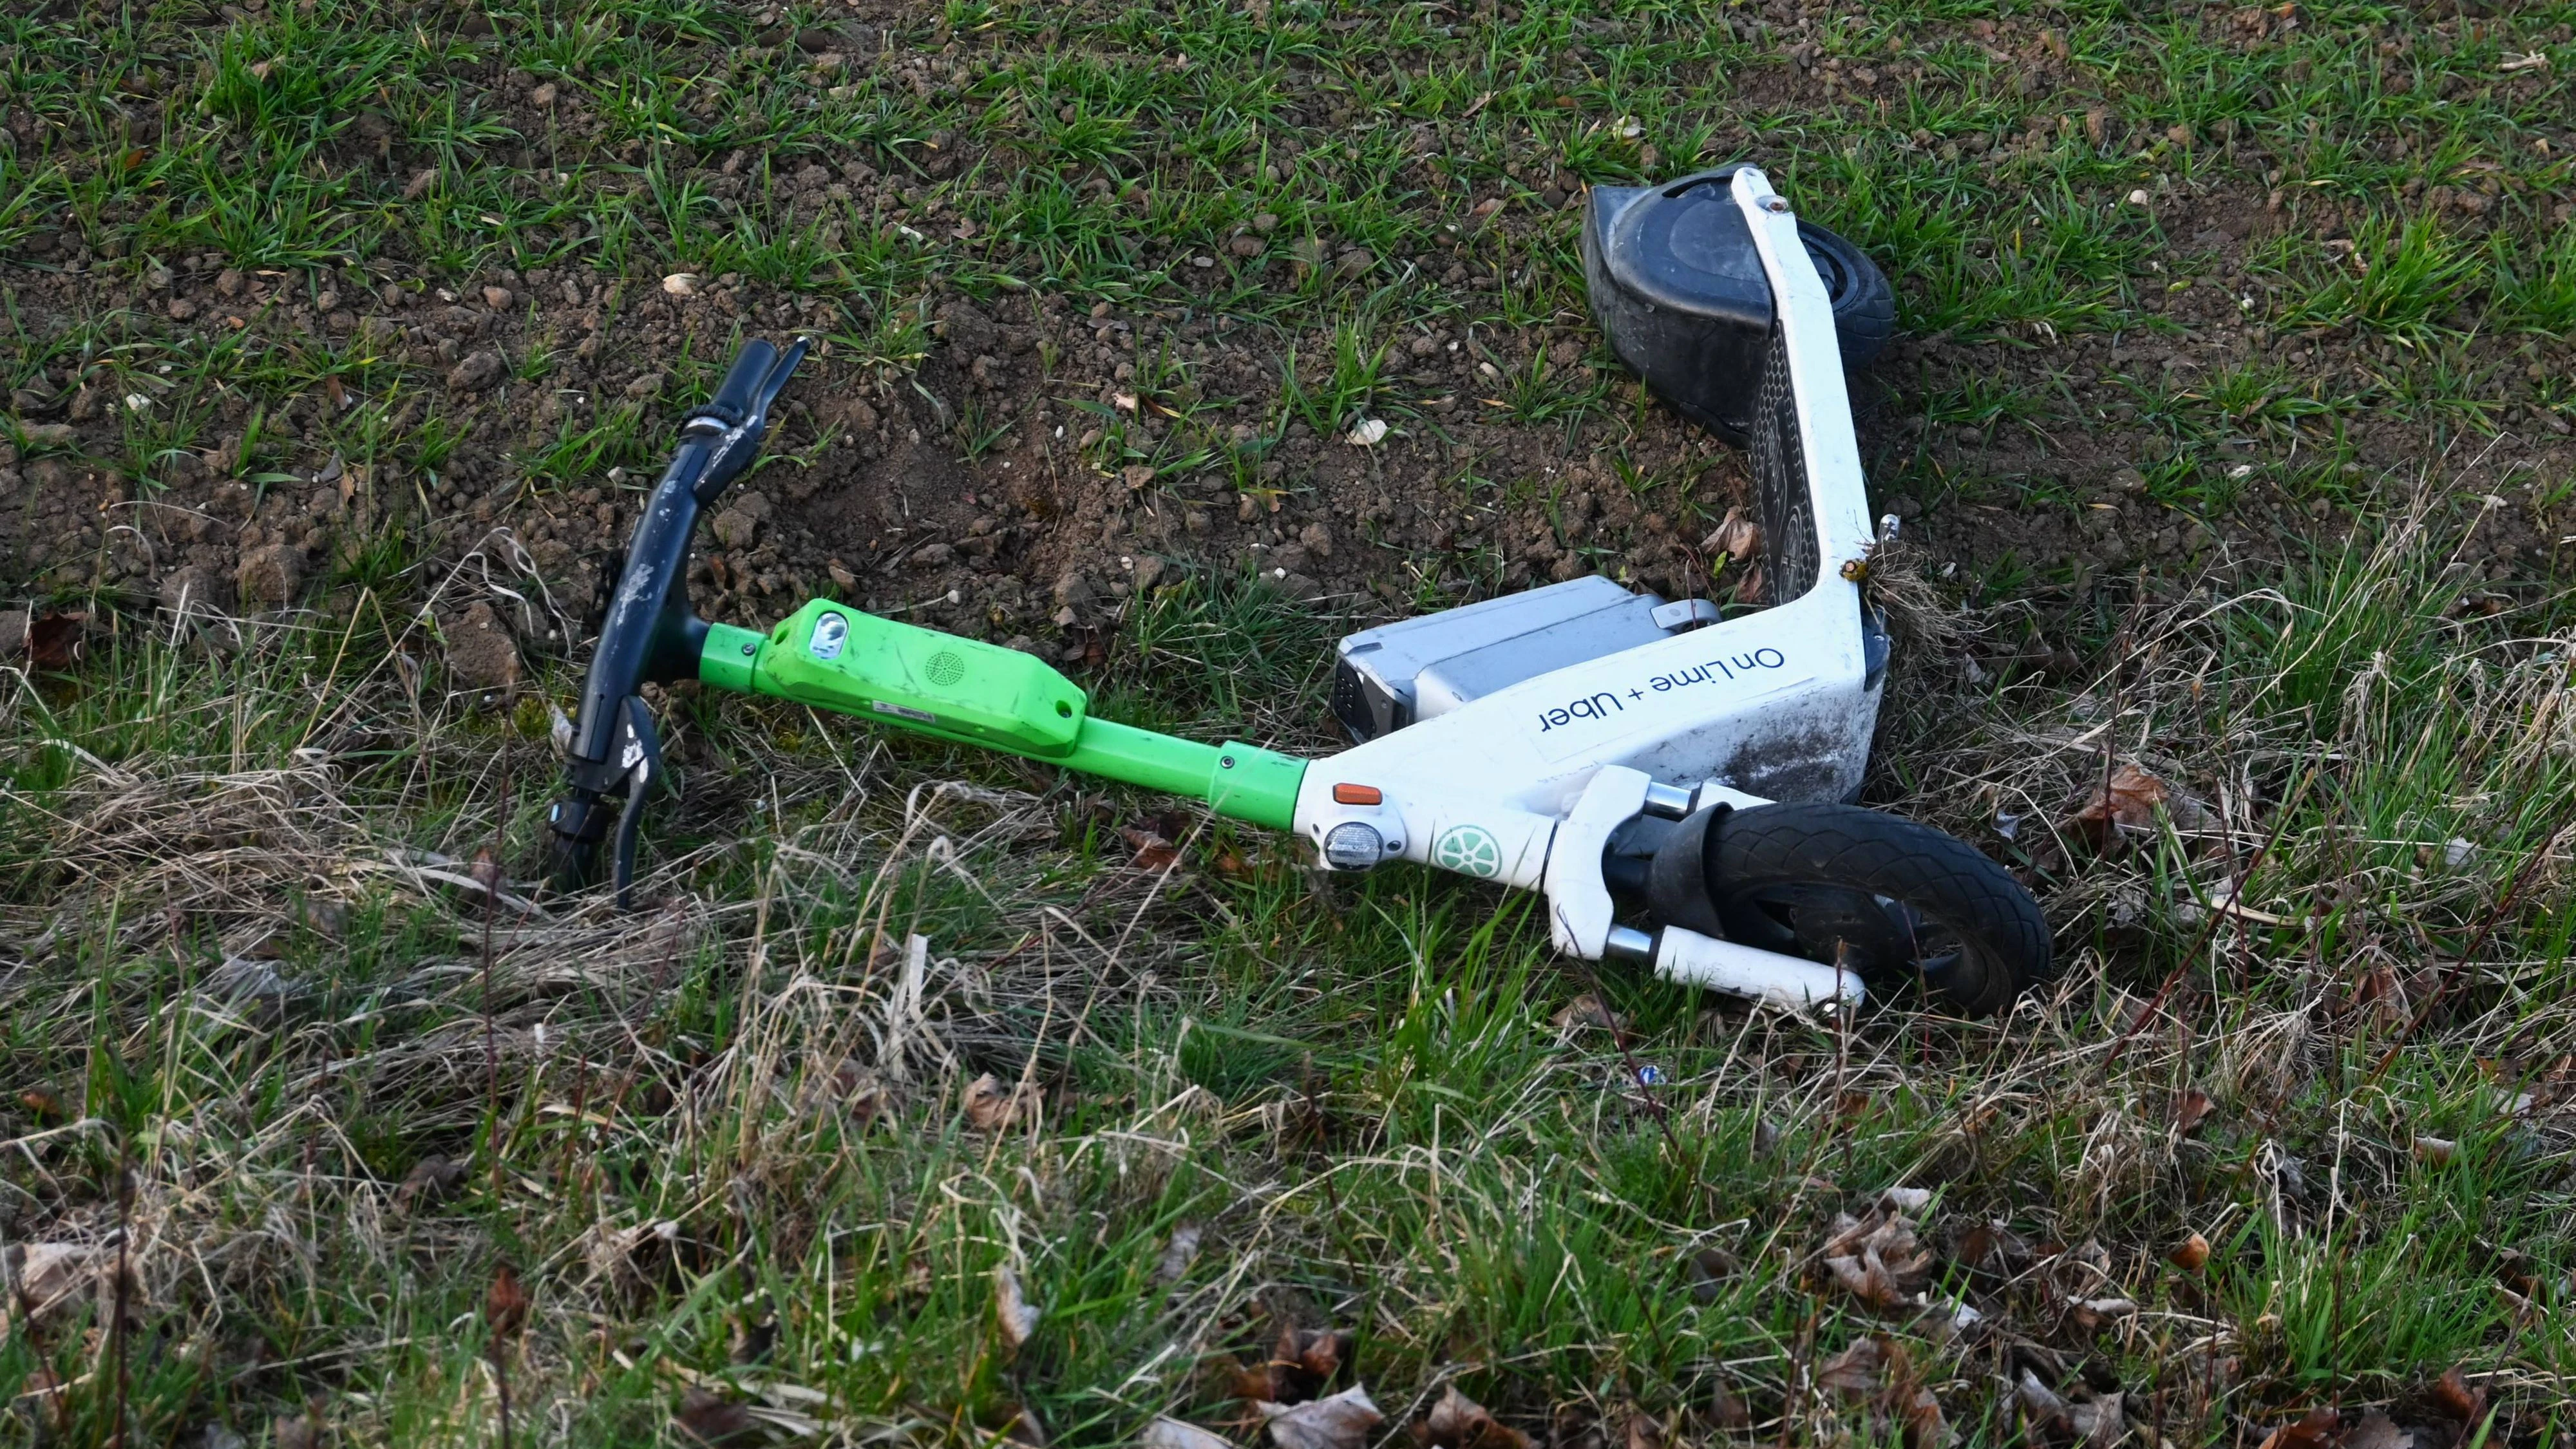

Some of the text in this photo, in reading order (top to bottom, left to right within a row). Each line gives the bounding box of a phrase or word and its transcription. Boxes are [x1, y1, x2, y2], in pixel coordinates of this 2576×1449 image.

[1538, 648, 1785, 732] On Lime + Uber
